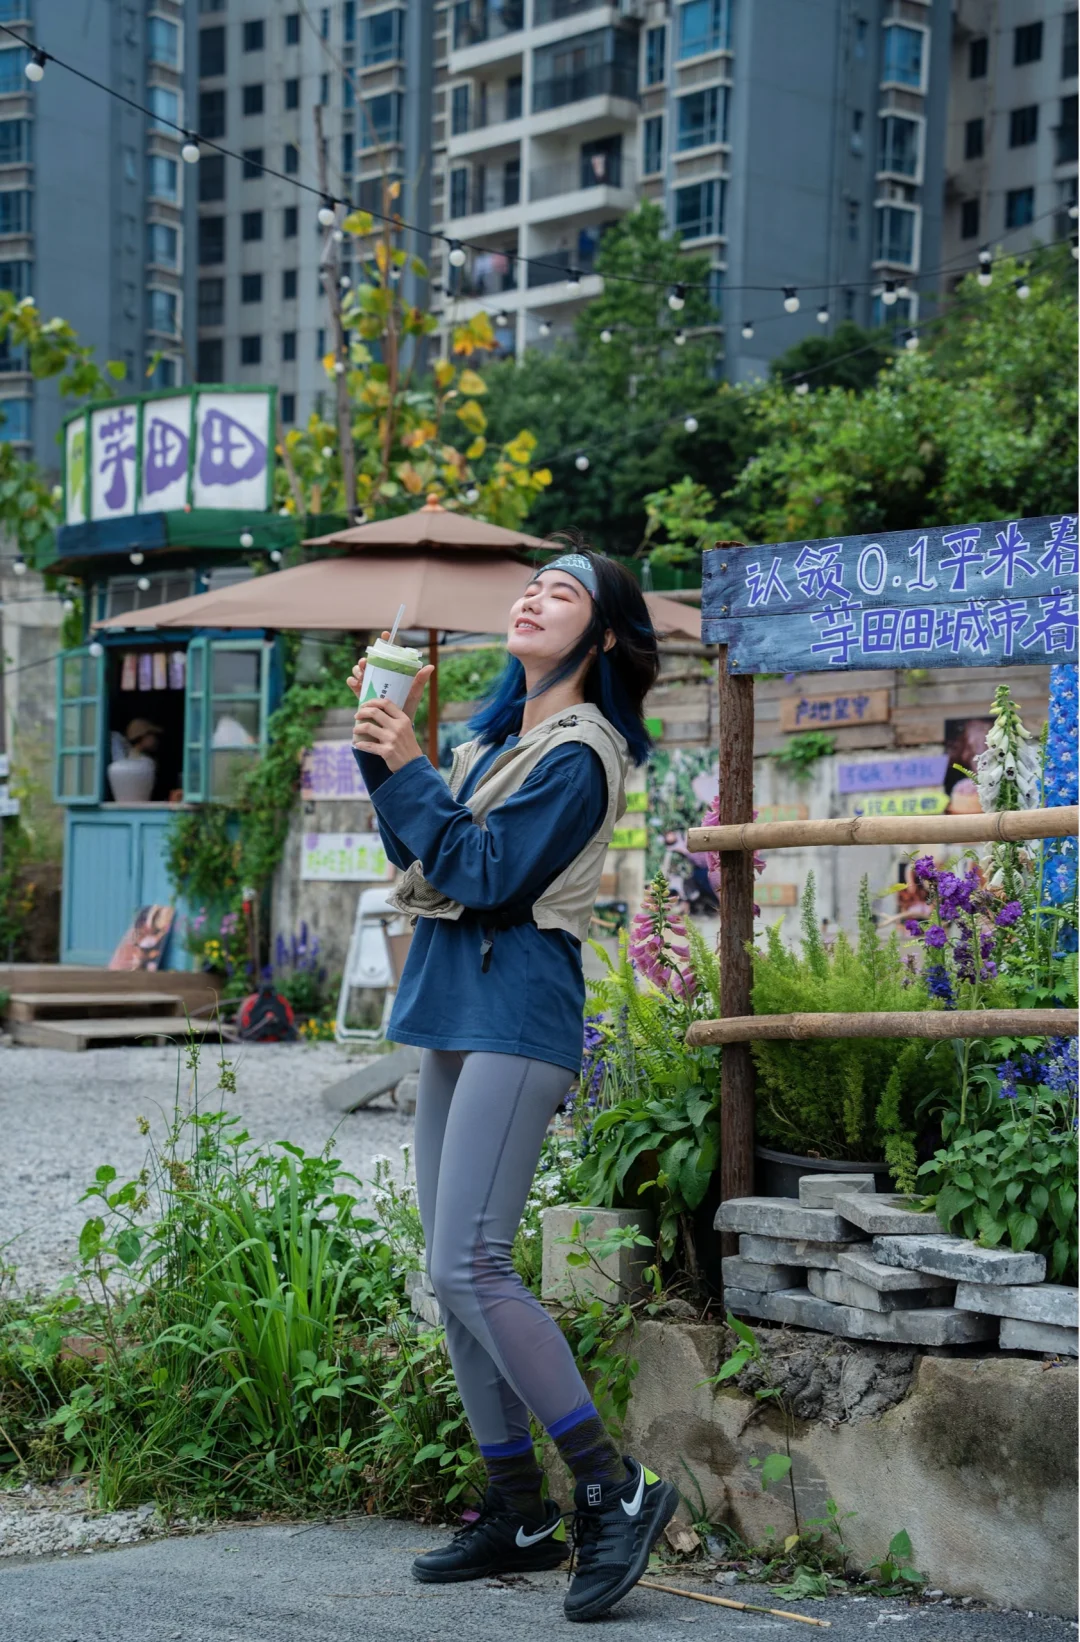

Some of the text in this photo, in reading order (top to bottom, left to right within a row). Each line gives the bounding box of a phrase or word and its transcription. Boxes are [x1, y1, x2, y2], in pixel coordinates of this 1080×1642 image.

[745, 516, 1079, 607] 认领0.1平米春
[810, 586, 1079, 665] 芋田田城市春
